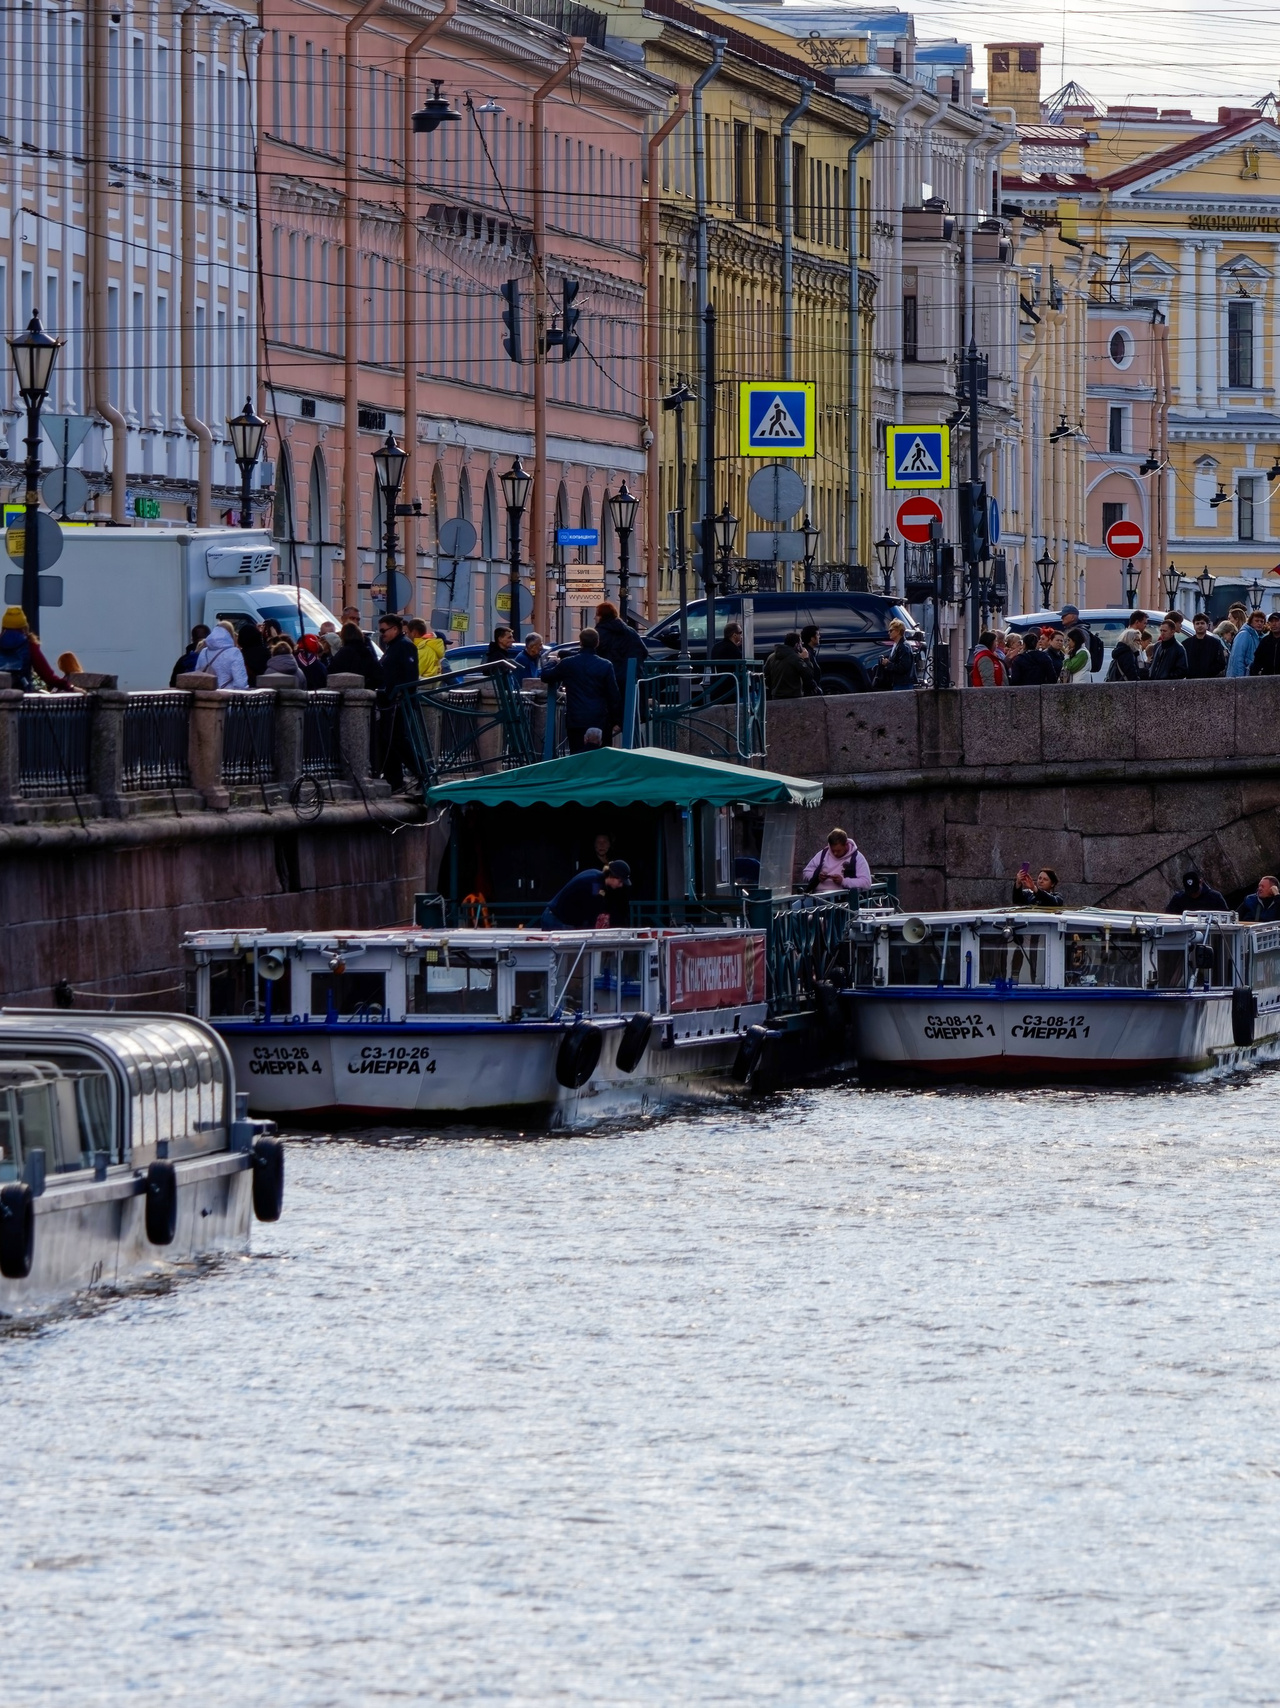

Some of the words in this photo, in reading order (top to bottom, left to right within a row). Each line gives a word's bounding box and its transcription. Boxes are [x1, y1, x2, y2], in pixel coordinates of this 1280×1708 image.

[924, 1027, 984, 1039] СИЕРРА
[986, 1024, 996, 1037] 1
[1082, 1026, 1091, 1038] 1
[249, 1060, 309, 1075] СИЕРРА
[311, 1060, 322, 1074] 4
[426, 1060, 437, 1074] 4
